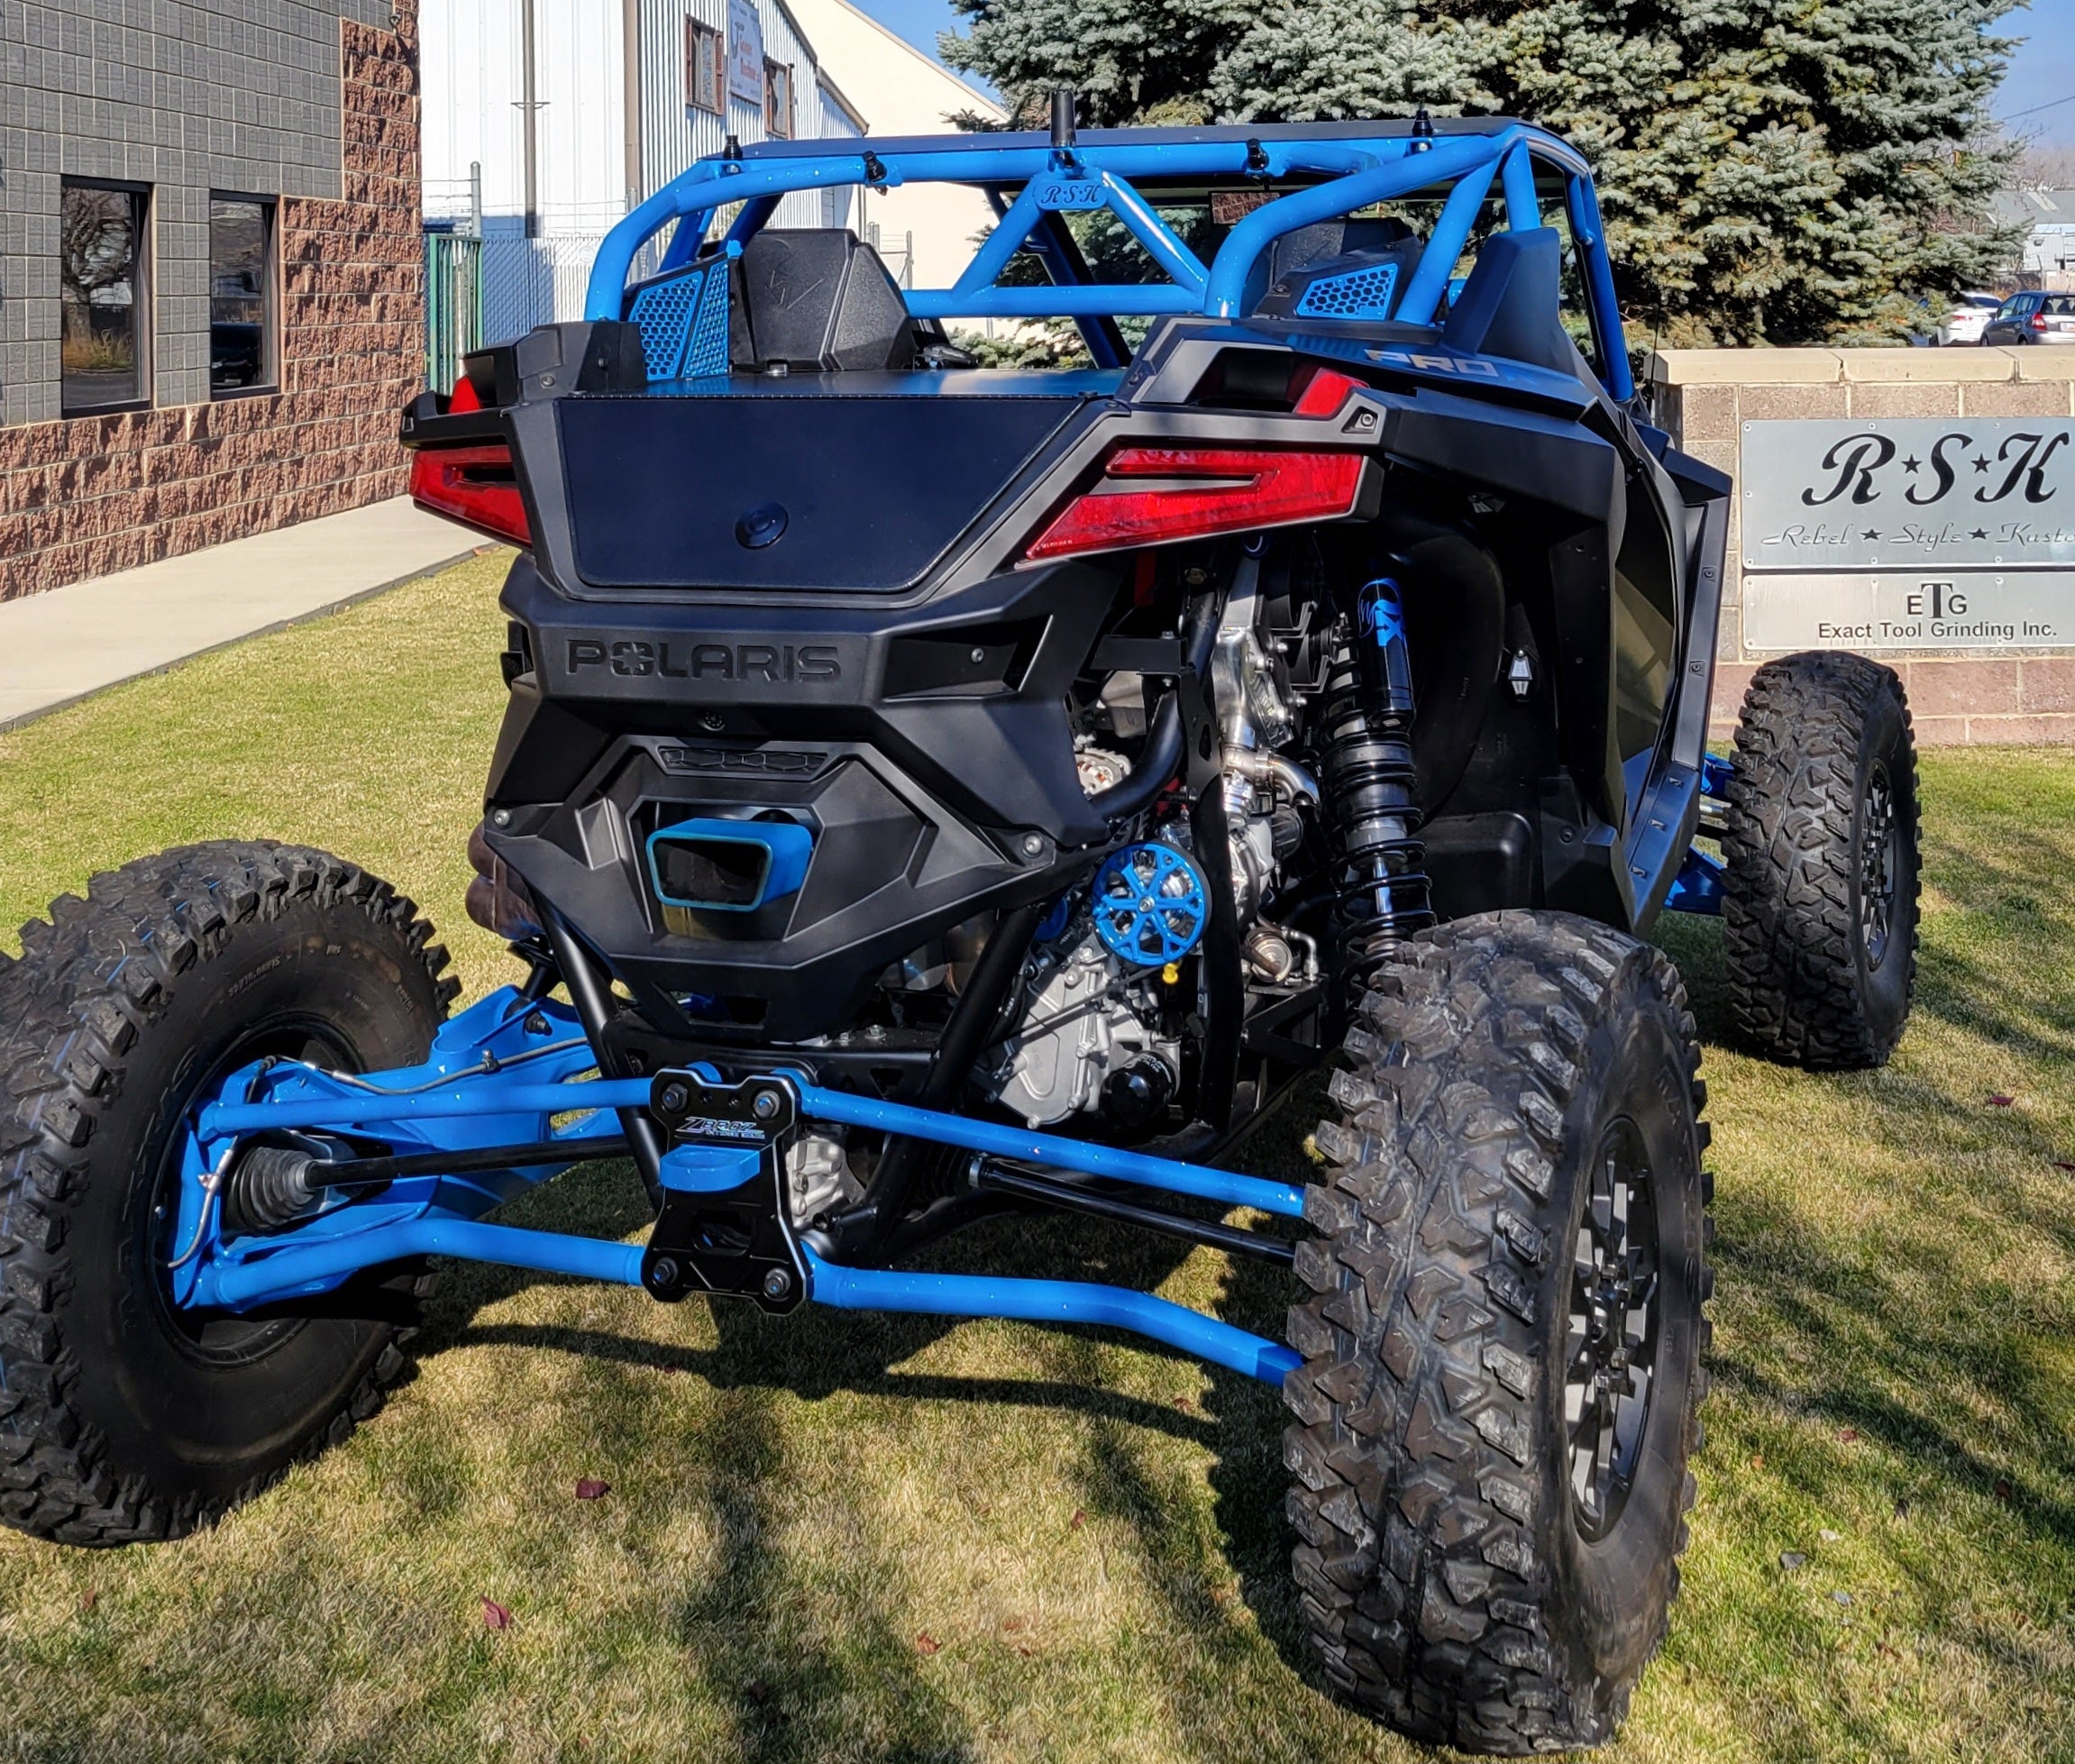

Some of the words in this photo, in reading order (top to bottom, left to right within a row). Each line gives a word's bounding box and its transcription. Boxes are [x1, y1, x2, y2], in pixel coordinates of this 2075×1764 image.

[1760, 524, 1853, 547] Rebel
[1888, 523, 1961, 552] Style
[1906, 582, 1968, 618] ETG
[1818, 622, 1872, 638] Exact
[1879, 622, 1922, 637] Tool
[1931, 621, 2015, 639] Grinding
[2023, 621, 2057, 636] Inc.
[566, 639, 842, 682] POLARIS
